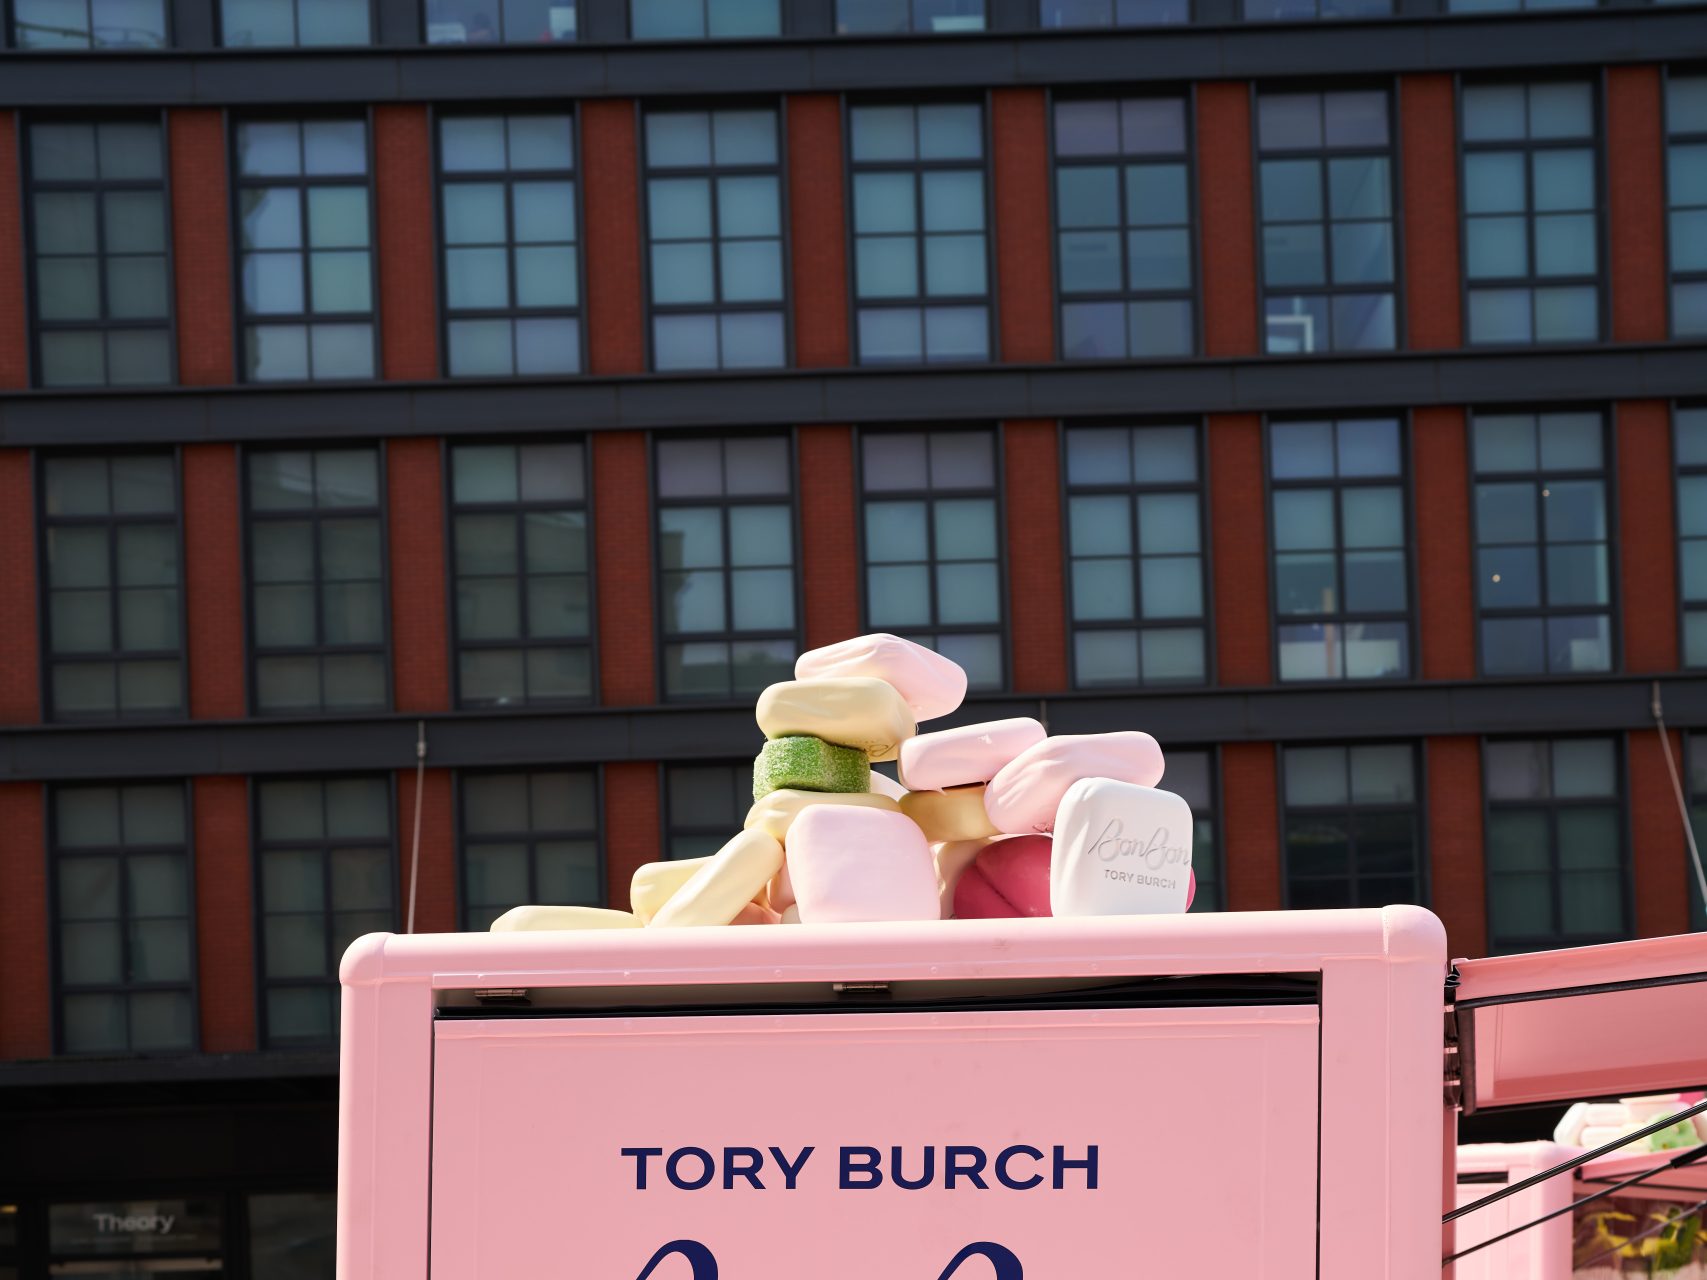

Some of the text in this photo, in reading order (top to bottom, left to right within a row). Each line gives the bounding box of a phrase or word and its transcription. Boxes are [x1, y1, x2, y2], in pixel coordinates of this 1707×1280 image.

[1088, 818, 1190, 870] BonBon
[1104, 868, 1176, 889] TORY BURCH
[621, 1145, 1099, 1191] TORY BURCH
[93, 1213, 175, 1234] Theory
